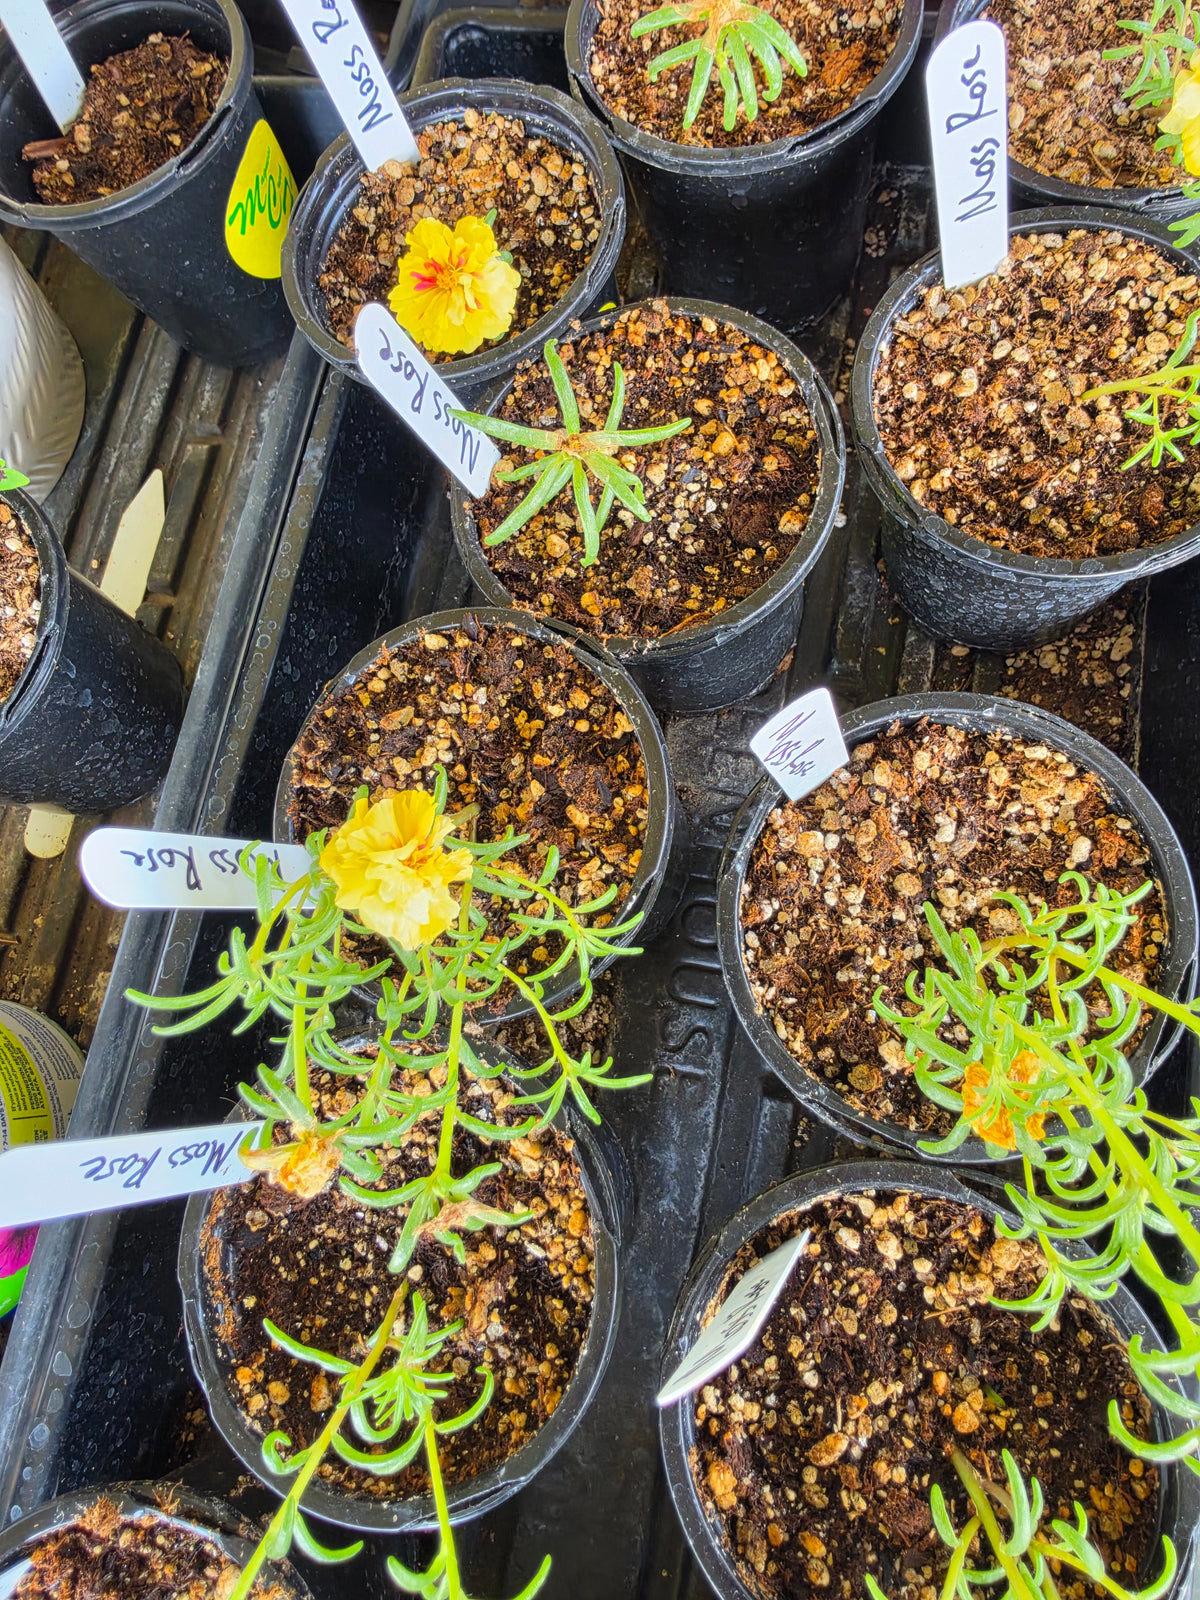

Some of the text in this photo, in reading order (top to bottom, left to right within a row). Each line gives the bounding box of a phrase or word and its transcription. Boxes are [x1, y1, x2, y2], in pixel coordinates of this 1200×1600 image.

[344, 44, 393, 133] Moss
[945, 44, 1000, 222] Moss Rose
[379, 328, 429, 414] Rose
[764, 710, 825, 777] Moss Rose
[120, 846, 202, 890] Rose
[79, 1130, 244, 1189] Moss Rose
